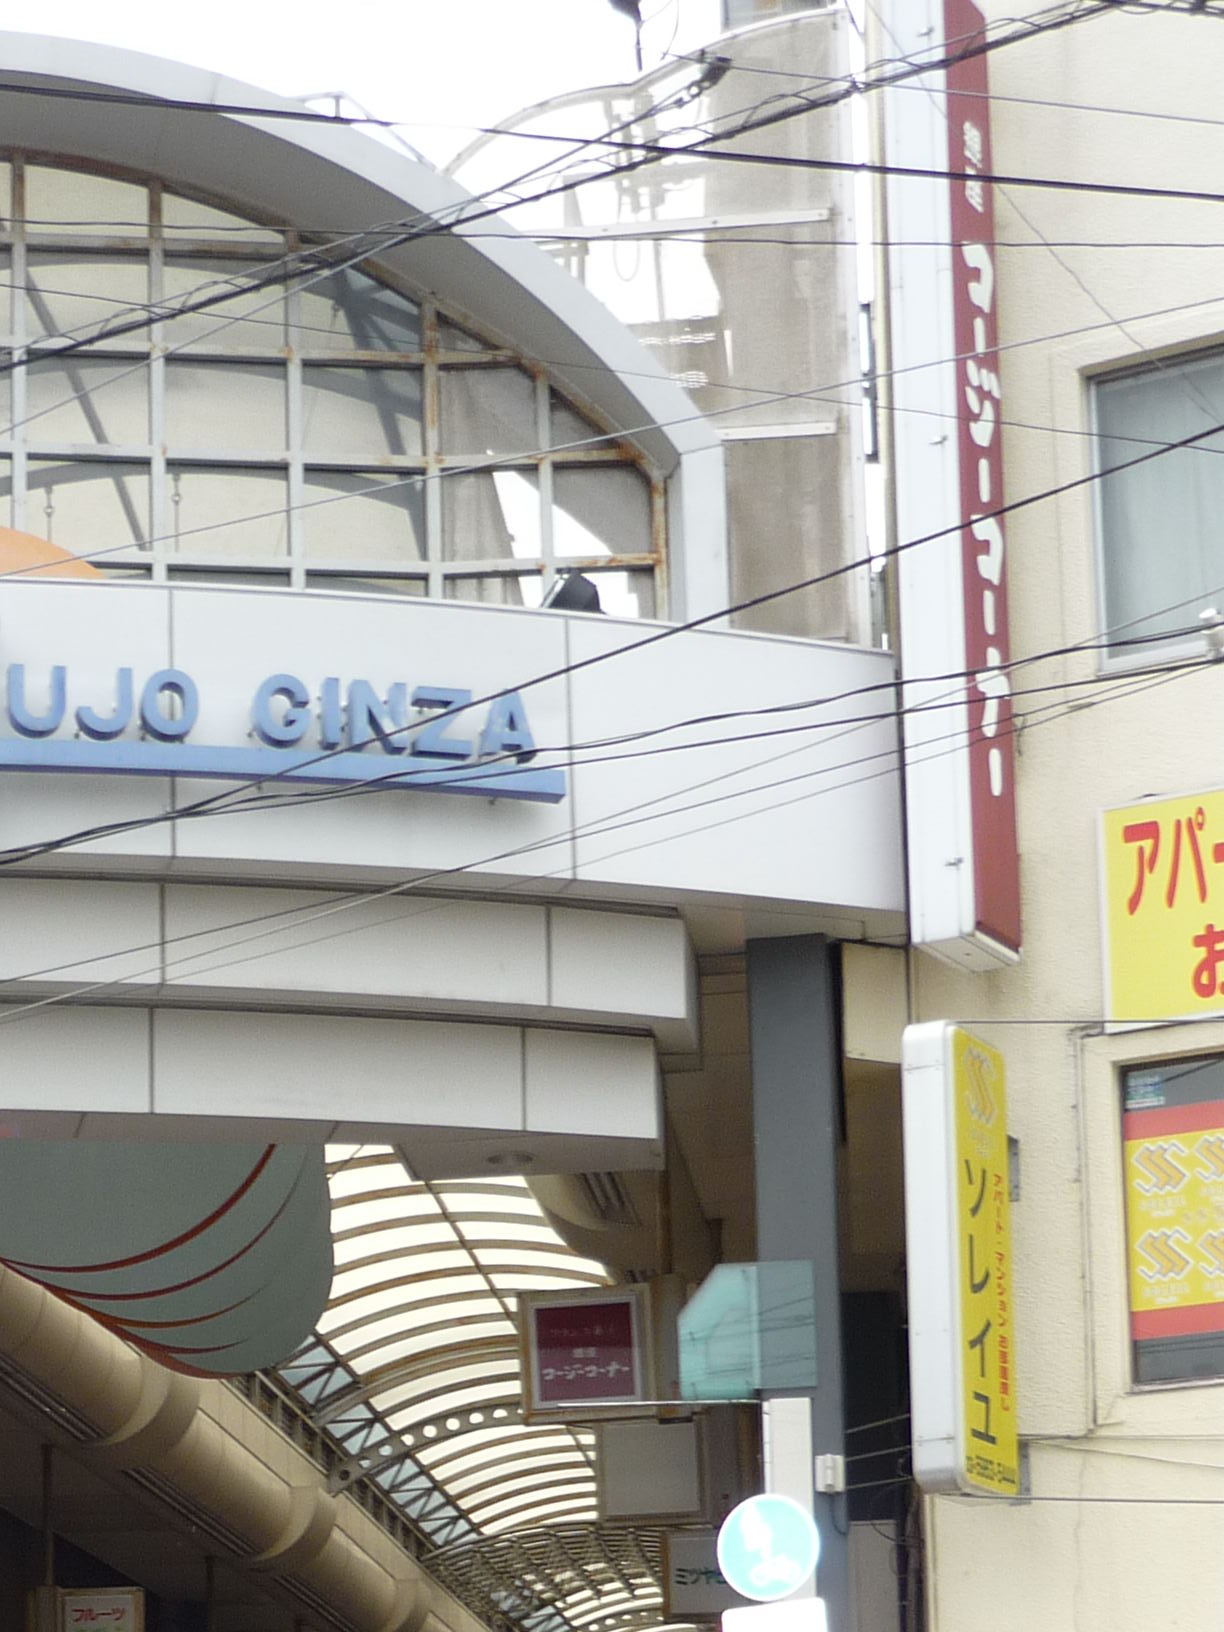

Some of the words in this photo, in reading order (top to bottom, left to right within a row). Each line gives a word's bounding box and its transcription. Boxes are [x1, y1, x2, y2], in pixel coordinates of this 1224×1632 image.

[250, 672, 540, 765] GINZA
[1122, 807, 1224, 915] アパ
[963, 1158, 998, 1446] ソレイユ
[72, 1607, 126, 1622] フルーツ
